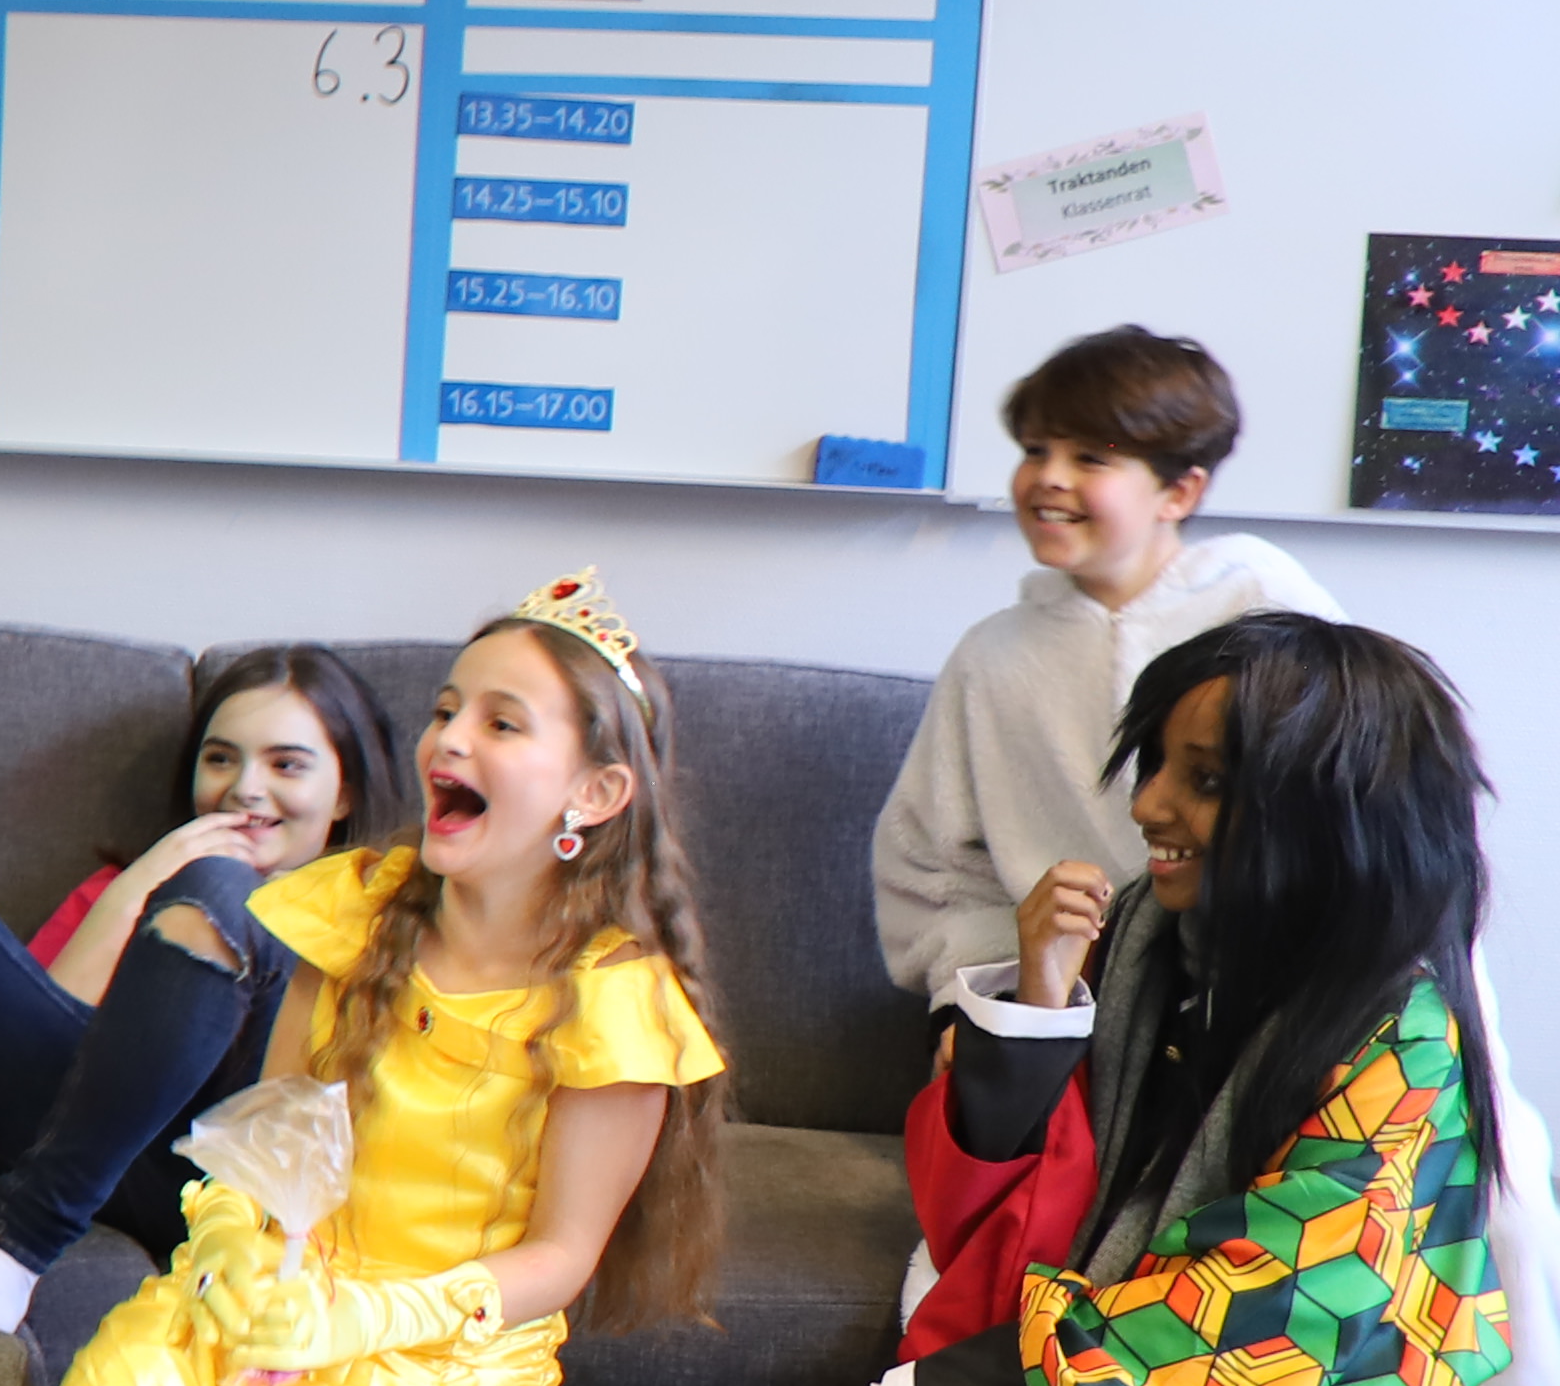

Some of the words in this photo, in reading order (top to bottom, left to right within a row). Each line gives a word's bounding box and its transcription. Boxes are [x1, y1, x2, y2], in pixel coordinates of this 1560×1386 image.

[310, 26, 411, 106] 6.3
[1047, 156, 1153, 196] Traktanden
[1061, 185, 1153, 220] Klassenrat
